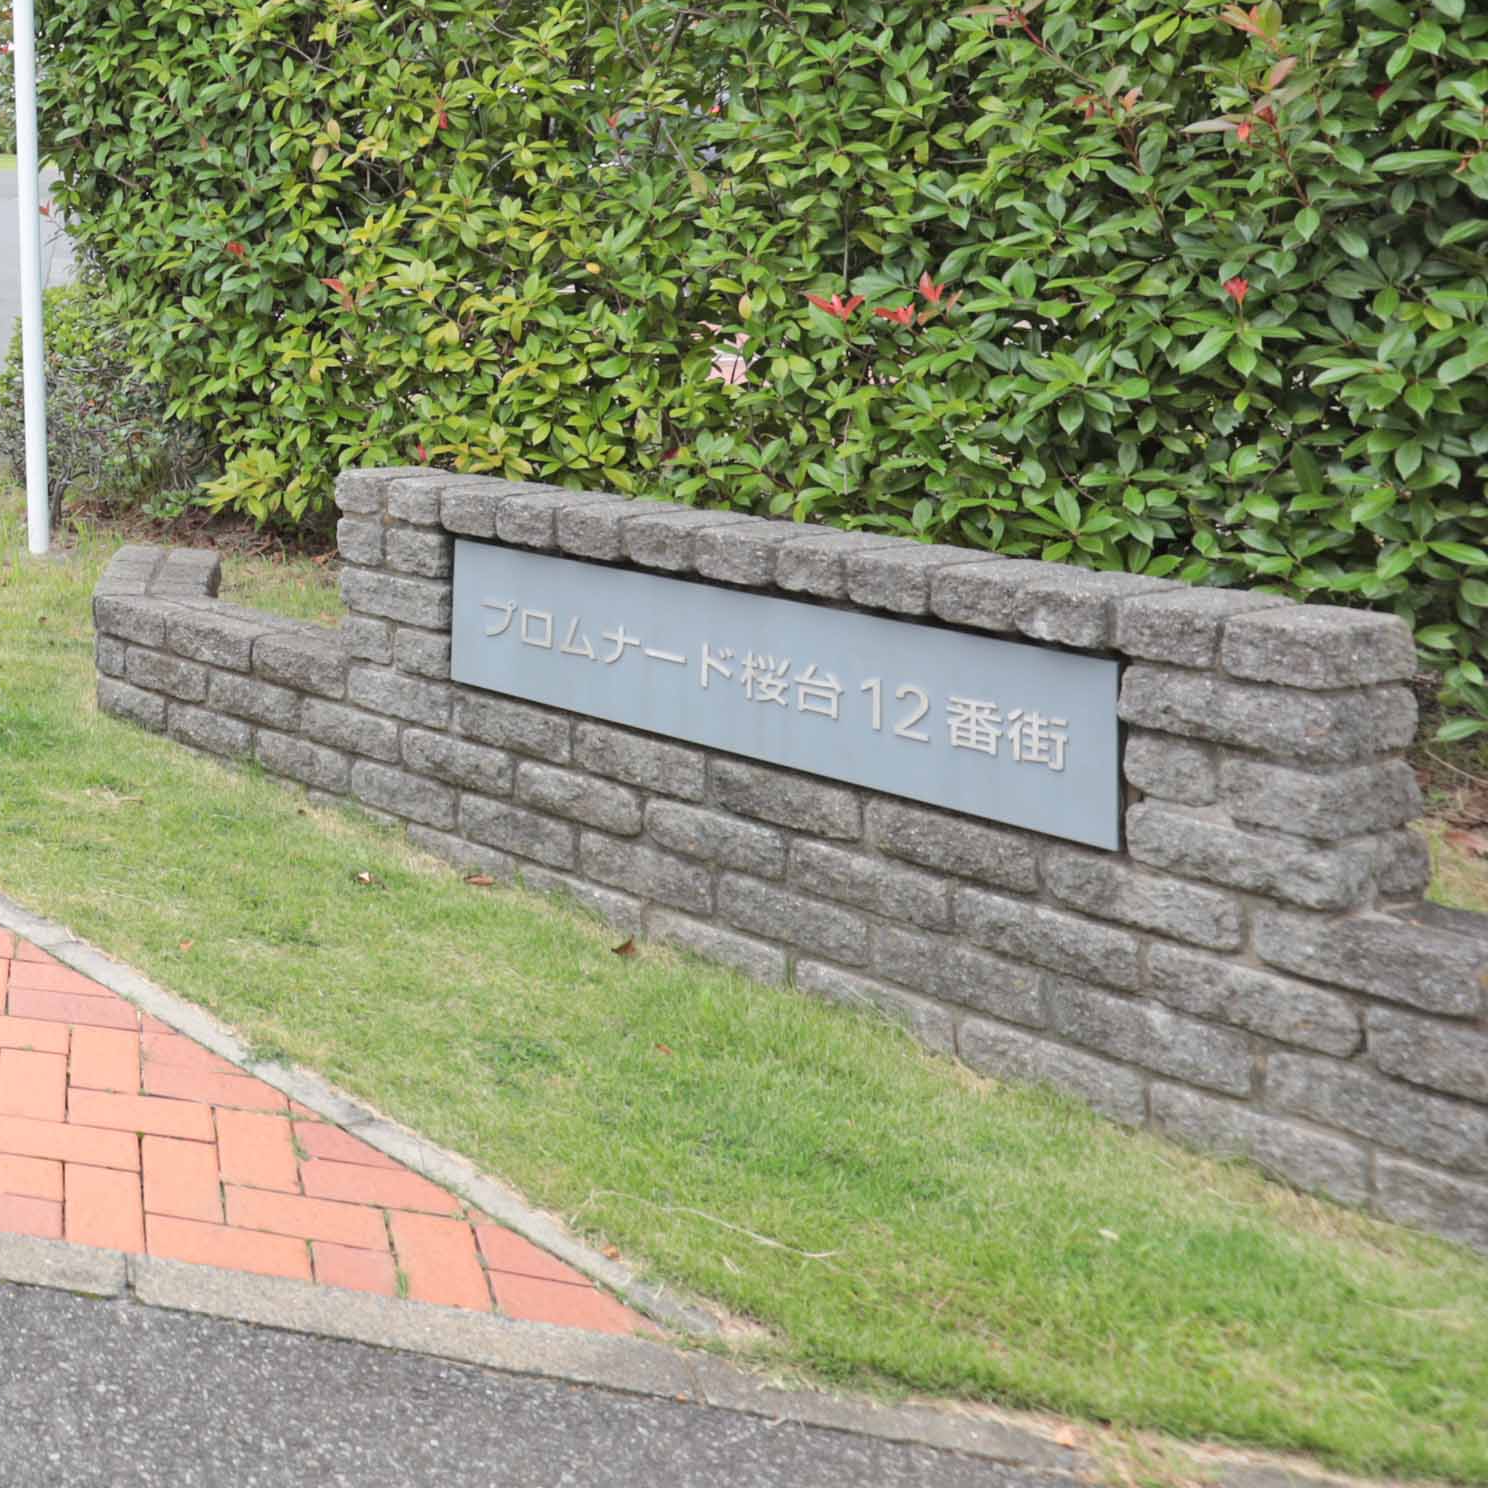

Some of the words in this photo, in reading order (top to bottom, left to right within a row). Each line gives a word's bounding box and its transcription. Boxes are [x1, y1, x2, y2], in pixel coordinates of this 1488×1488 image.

[480, 597, 1070, 772] プロムナード桜台12番街
